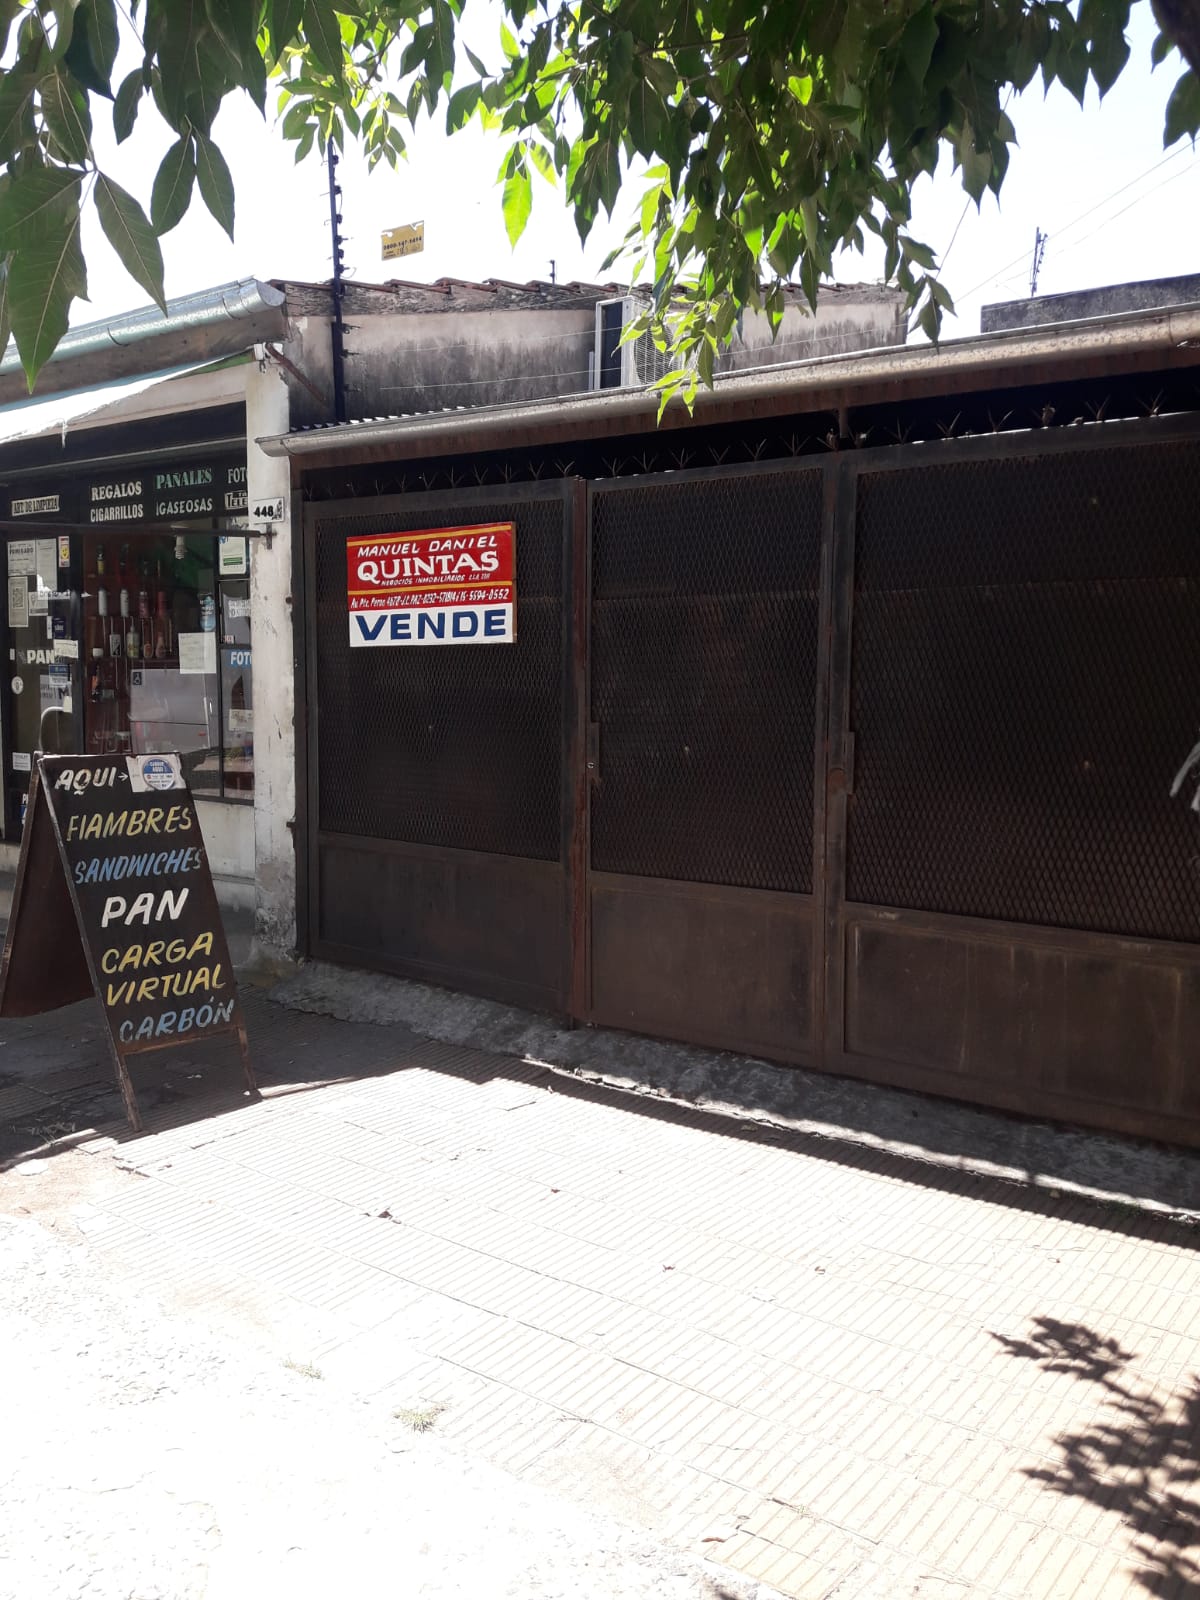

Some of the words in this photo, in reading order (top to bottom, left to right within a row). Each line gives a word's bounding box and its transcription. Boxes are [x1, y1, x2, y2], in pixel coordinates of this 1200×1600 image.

[91, 481, 142, 501] REGALOS
[156, 468, 213, 490] PAÑALES
[228, 467, 248, 484] FOT
[90, 504, 144, 522] CIGARRILLOS
[253, 505, 274, 517] 448
[357, 542, 420, 558] MANUEL
[428, 535, 498, 552] DANIEL
[357, 551, 499, 584] QUINTAS
[355, 608, 506, 641] VENDE
[54, 766, 118, 795] AQUI
[66, 805, 193, 842] FIAMBRES
[75, 847, 202, 885] SANDWICHES
[100, 887, 189, 928] PAN
[101, 931, 214, 975] CARGA
[106, 963, 227, 1006] VIRTUAL
[119, 996, 235, 1043] CARBÓN
